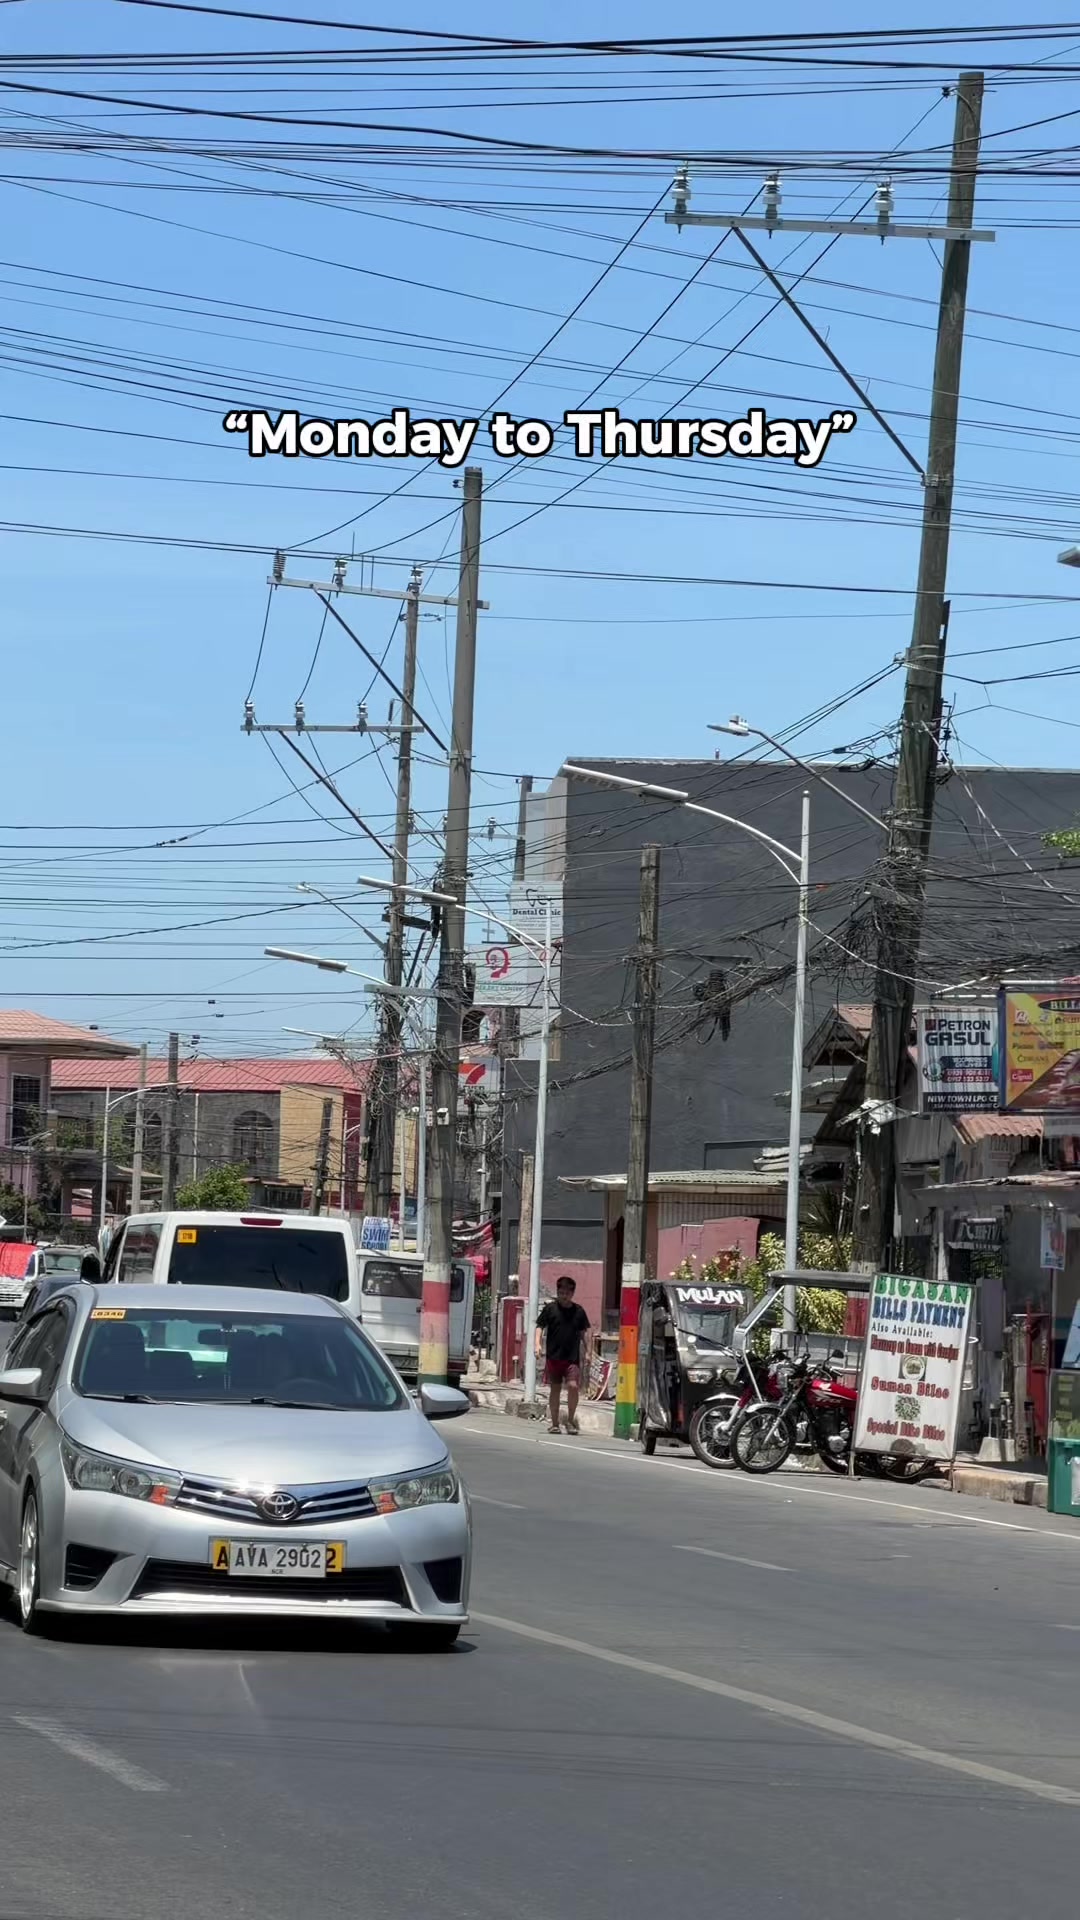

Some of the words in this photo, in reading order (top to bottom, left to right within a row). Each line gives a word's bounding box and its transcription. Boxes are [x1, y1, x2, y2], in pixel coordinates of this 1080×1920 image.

[512, 908, 537, 916] Dental
[538, 908, 561, 916] Clnic
[1050, 1000, 1080, 1010] BILL
[938, 1019, 991, 1031] PETRON
[925, 1032, 991, 1046] GASUL
[927, 1095, 947, 1103] NEW
[947, 1095, 972, 1103] TOWN
[872, 1296, 907, 1322] BILLS
[911, 1302, 966, 1329] PAYMENT
[871, 1321, 890, 1333] Also
[892, 1323, 934, 1339] Available:
[871, 1376, 912, 1395] Suman
[916, 1381, 950, 1400] Bilao
[867, 1417, 898, 1436] Special
[235, 1547, 268, 1568] AVA
[276, 1548, 321, 1569] 2902
